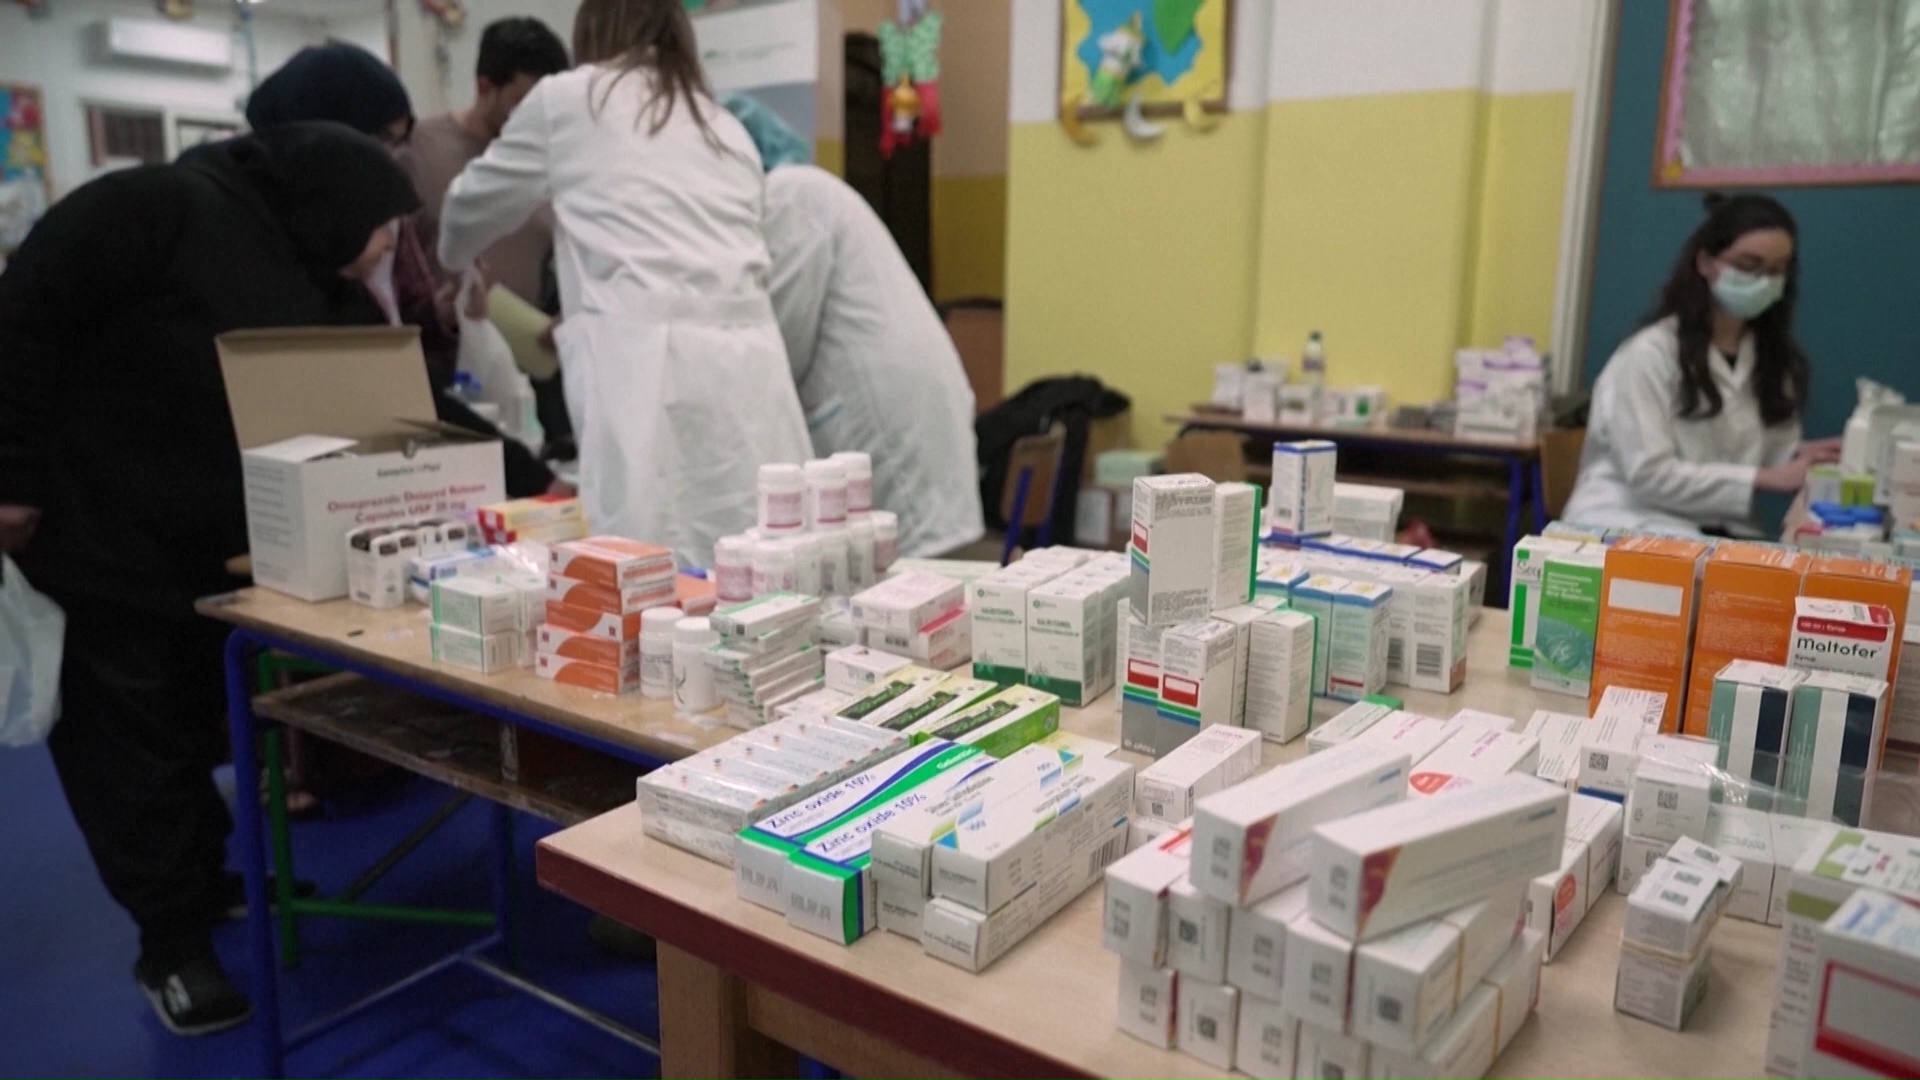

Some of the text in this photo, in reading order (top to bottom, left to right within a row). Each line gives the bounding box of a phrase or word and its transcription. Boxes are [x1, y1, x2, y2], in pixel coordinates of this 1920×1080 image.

[1797, 636, 1878, 658] Maltofer
[766, 808, 803, 829] Zinc
[804, 787, 845, 811] oxide
[818, 830, 856, 854] Zinc
[855, 805, 897, 834] oxide
